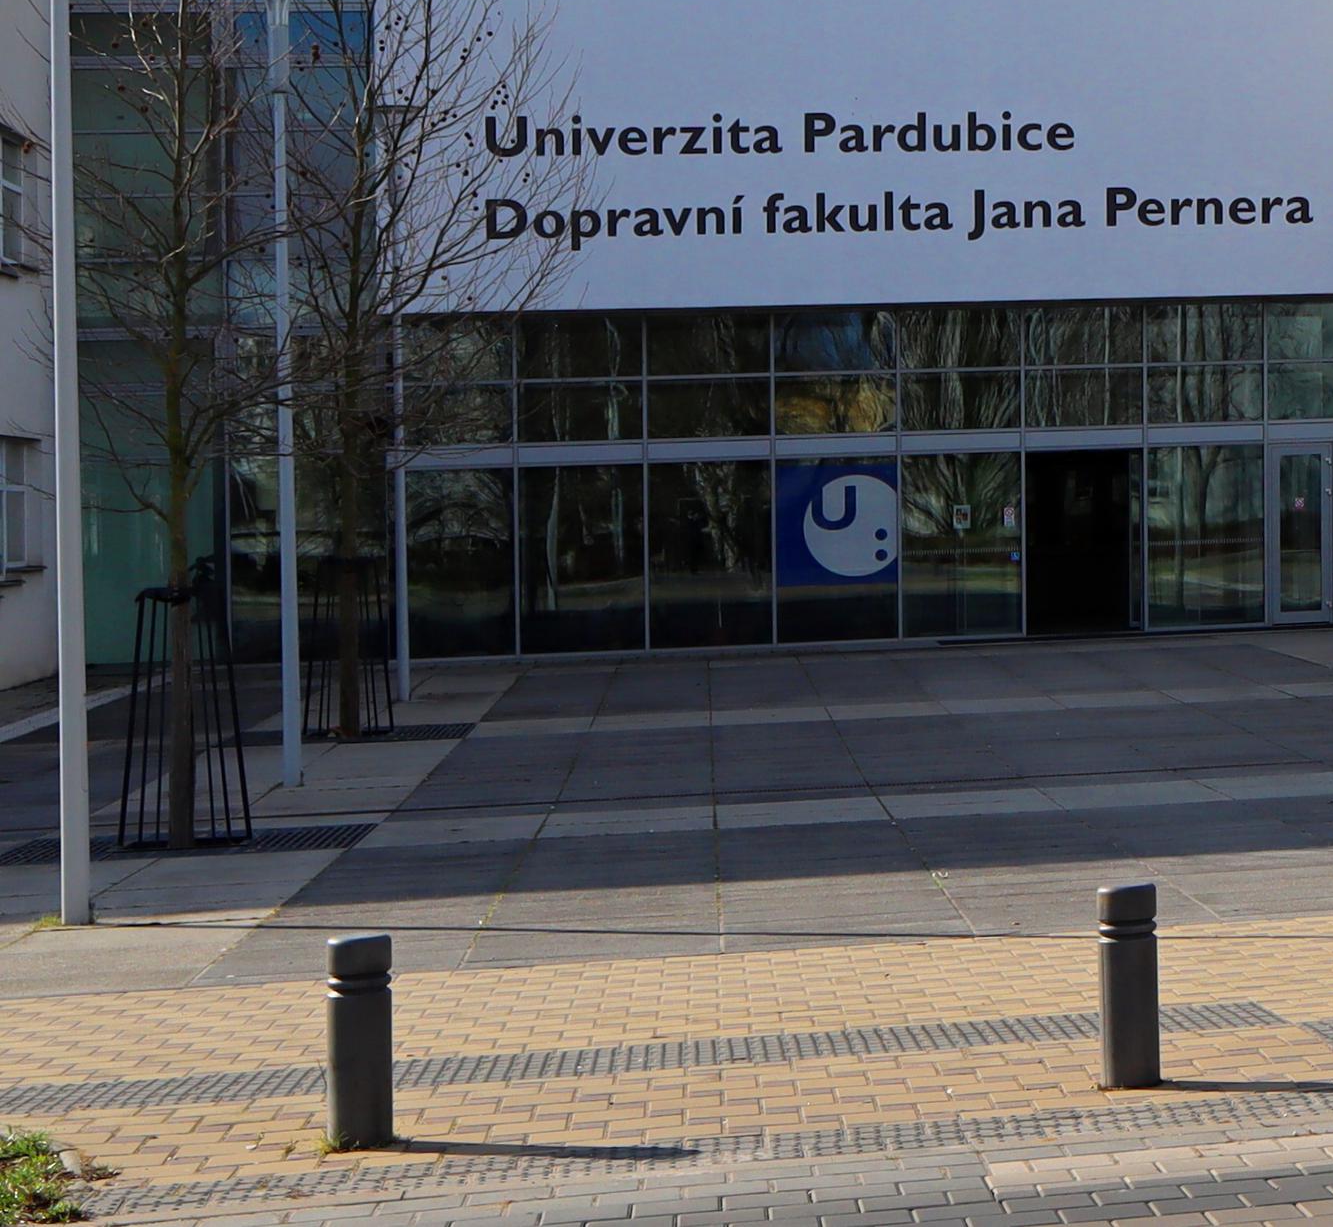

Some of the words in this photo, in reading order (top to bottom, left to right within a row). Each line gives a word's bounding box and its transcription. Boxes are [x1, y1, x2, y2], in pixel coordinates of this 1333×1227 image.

[485, 113, 782, 158] Univerzita
[804, 111, 1075, 153] Pardubice
[485, 193, 743, 251] Dopravní
[763, 191, 954, 234] fakulta
[968, 189, 1086, 241] Jana
[1106, 187, 1314, 227] Pernera
